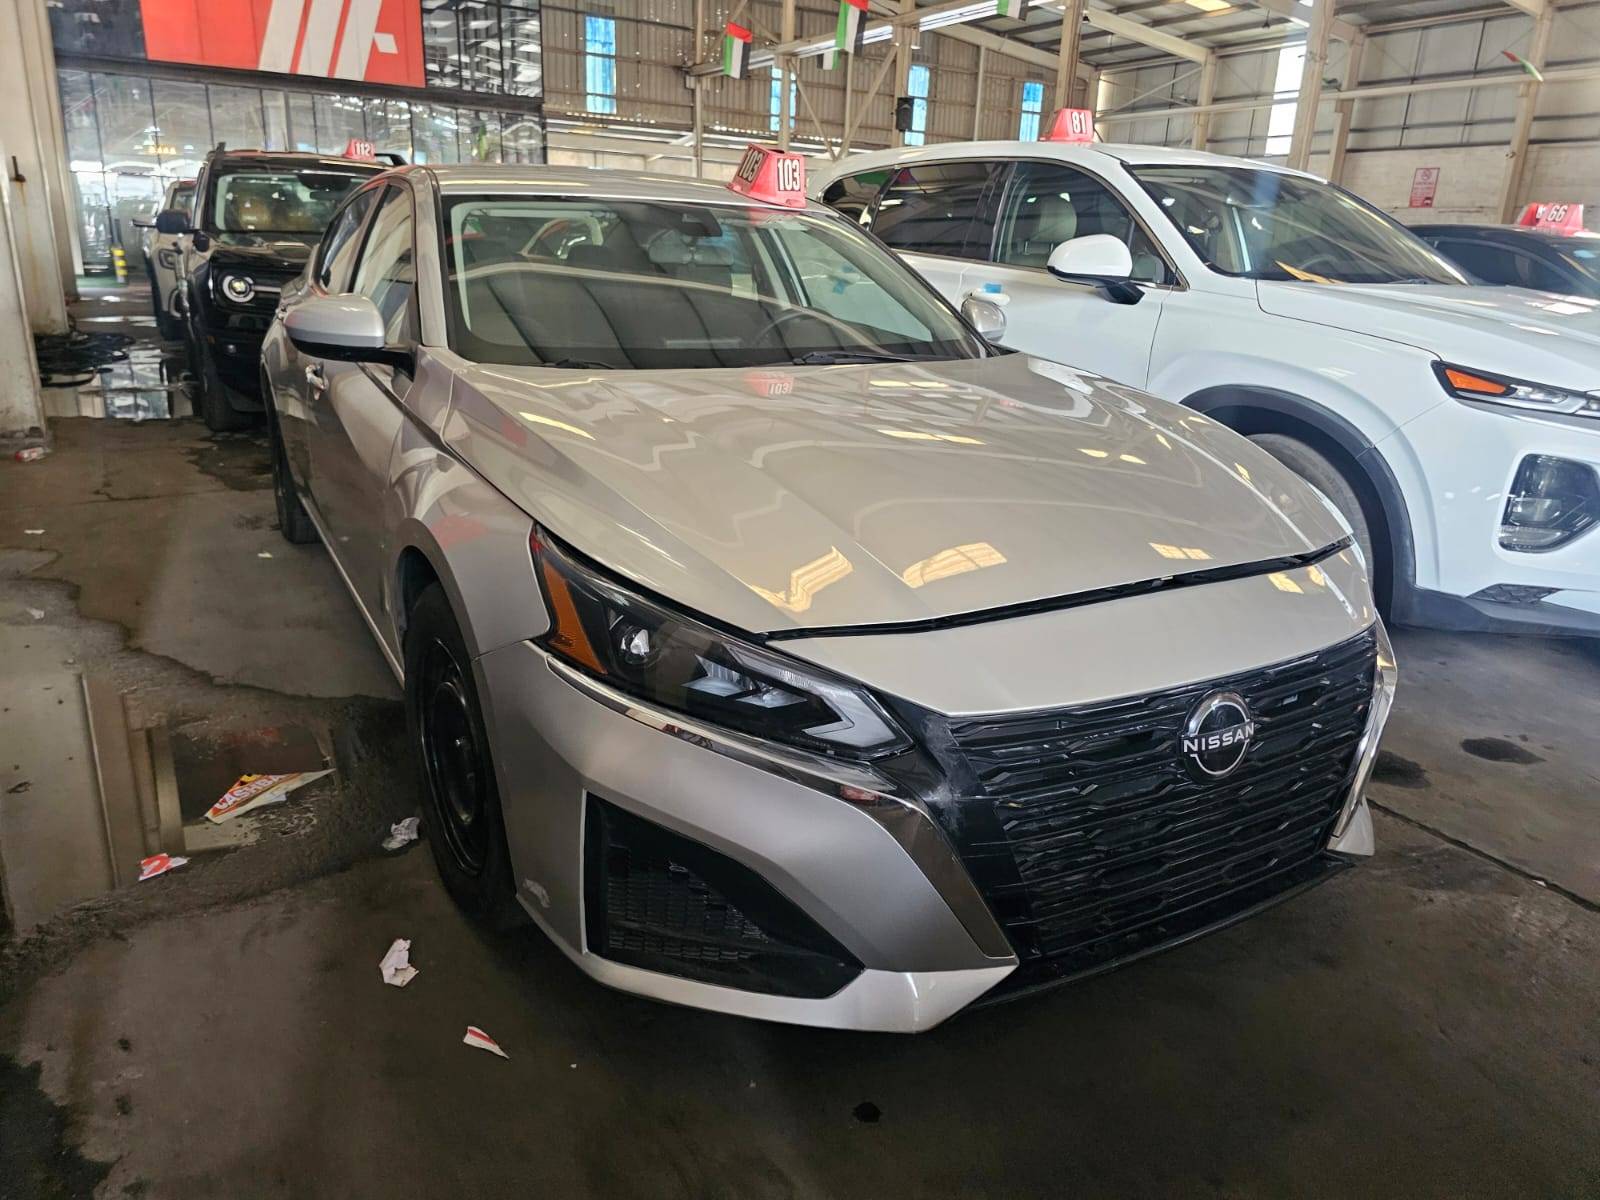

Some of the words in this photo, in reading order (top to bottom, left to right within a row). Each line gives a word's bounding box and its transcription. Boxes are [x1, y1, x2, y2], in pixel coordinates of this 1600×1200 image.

[1071, 111, 1087, 134] 81
[355, 142, 371, 157] 112
[738, 149, 764, 183] 103
[777, 158, 801, 191] 103
[1547, 205, 1568, 222] 66
[1183, 722, 1255, 753] NISSAN
